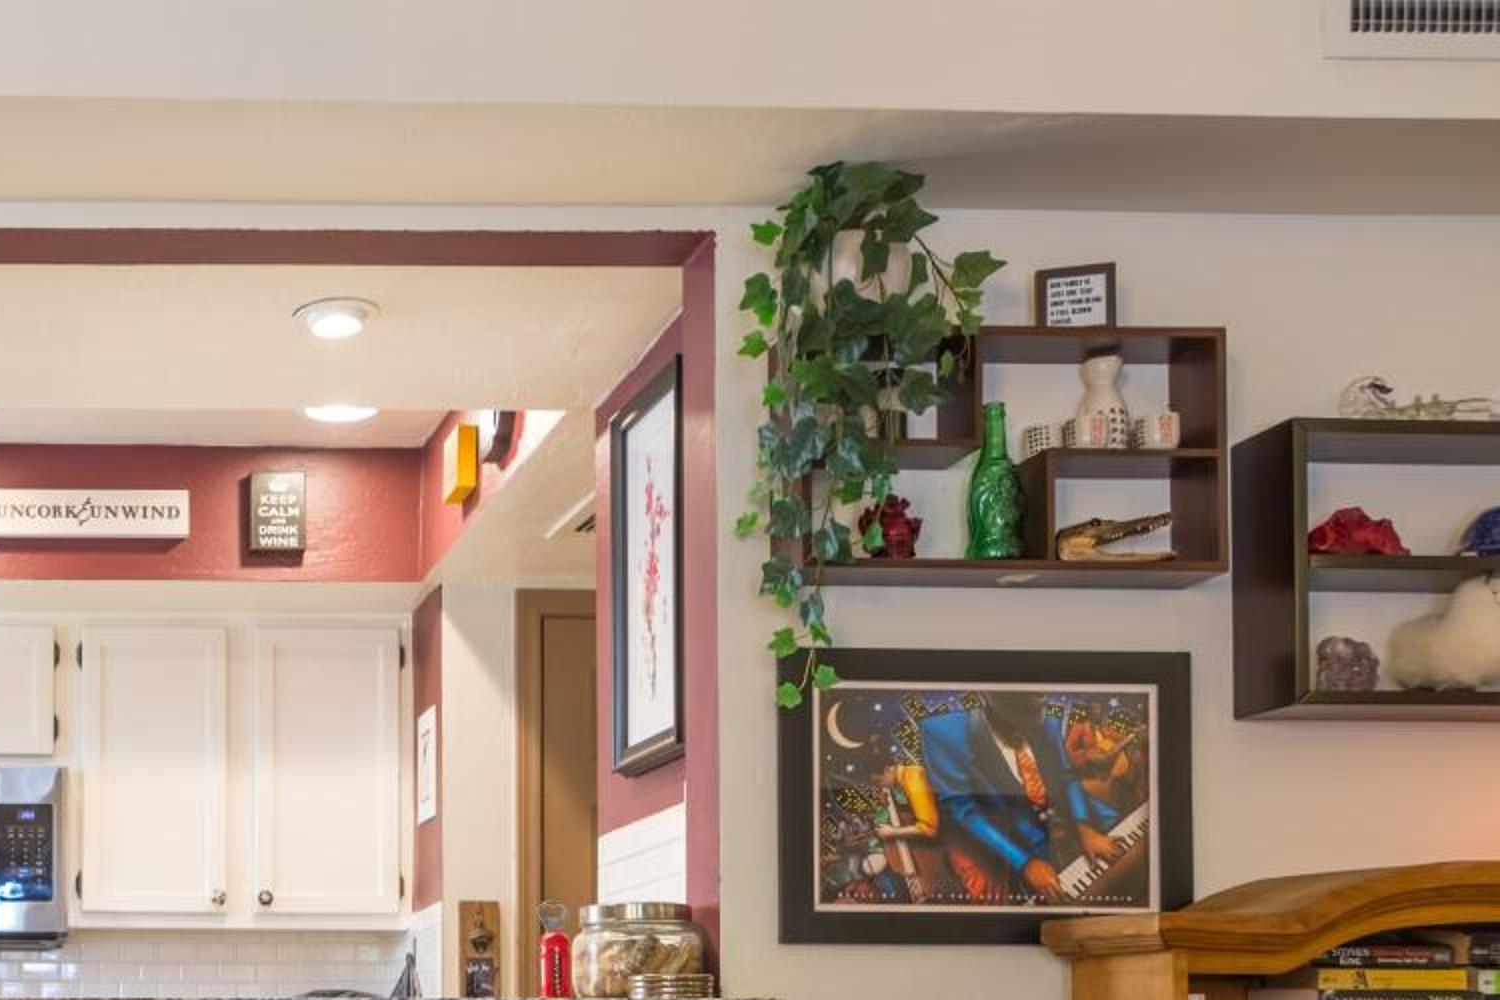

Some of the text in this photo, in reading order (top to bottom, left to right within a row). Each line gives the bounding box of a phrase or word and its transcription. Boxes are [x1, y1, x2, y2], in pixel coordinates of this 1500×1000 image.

[259, 494, 297, 505] KEEP
[90, 504, 180, 520] UNWIND
[258, 506, 299, 517] CALM
[259, 525, 298, 535] DRINK
[259, 536, 299, 547] WINE
